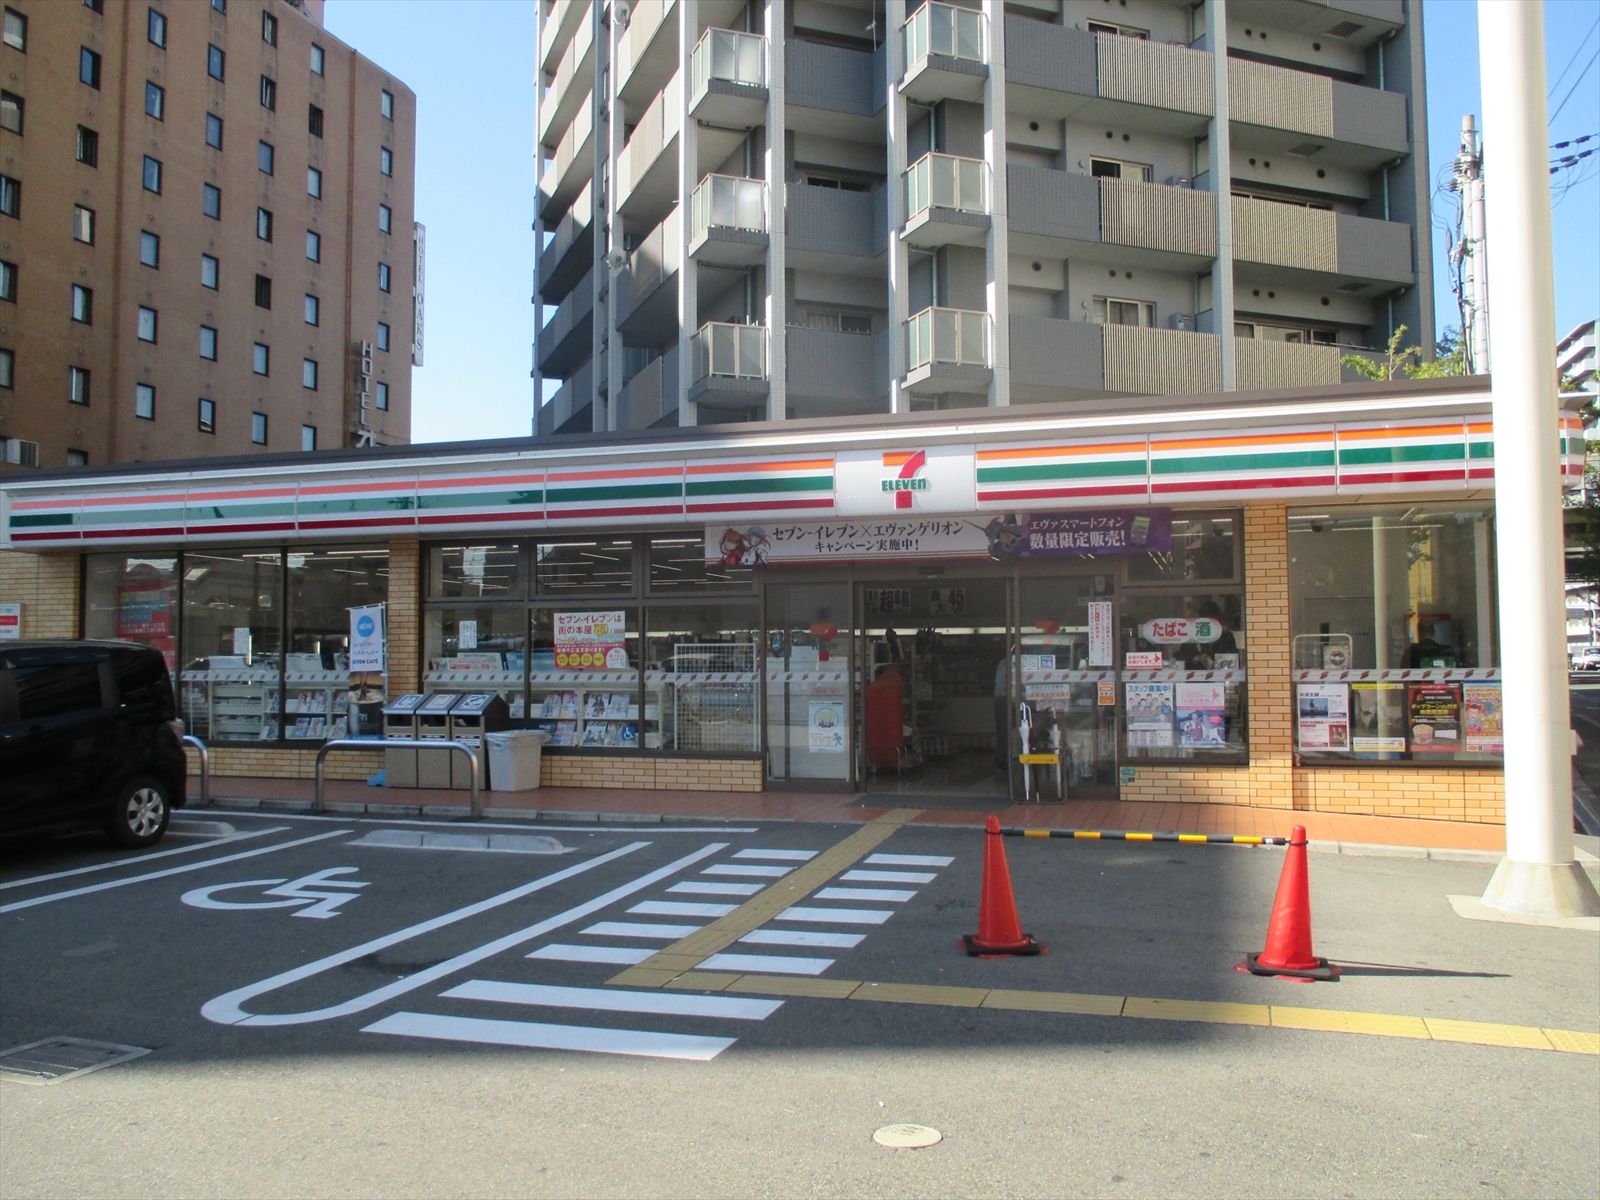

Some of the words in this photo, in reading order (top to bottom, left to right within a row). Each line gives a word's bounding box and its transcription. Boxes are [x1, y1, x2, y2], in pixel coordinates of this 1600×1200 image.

[416, 293, 424, 351] OAKS
[361, 339, 375, 429] HOTEL
[1152, 621, 1188, 637] たばこ
[1195, 621, 1211, 637] 酒
